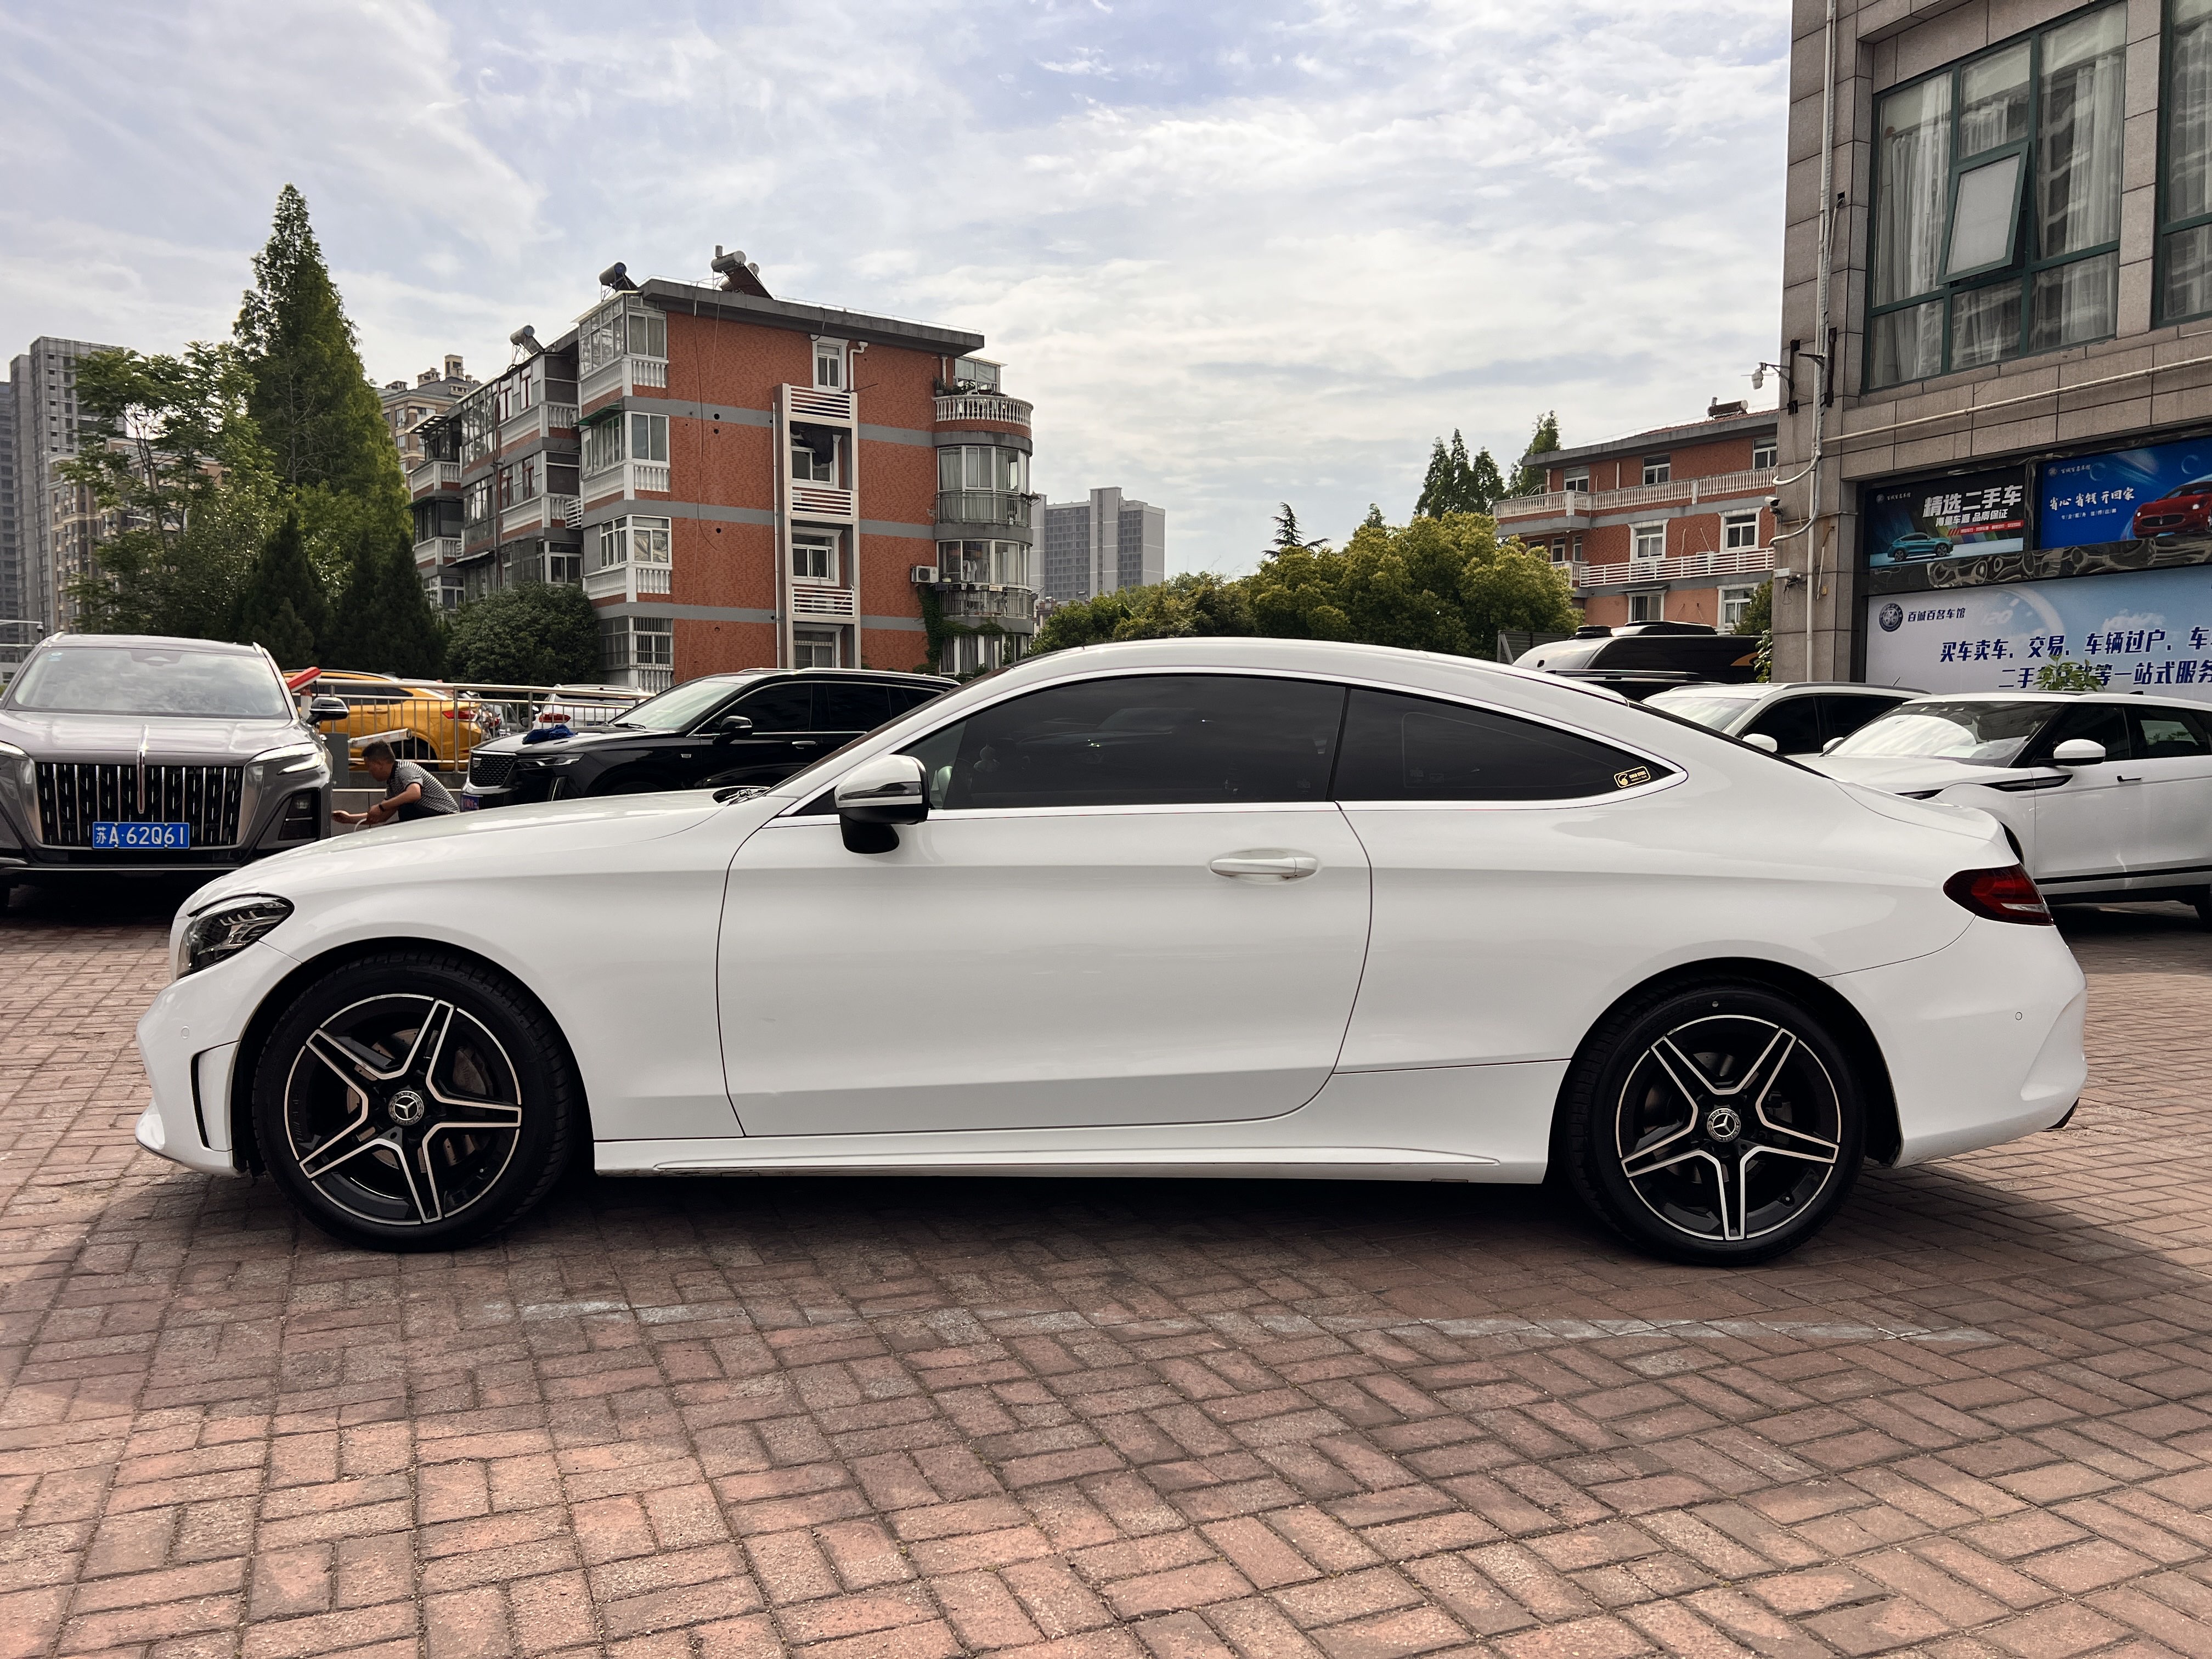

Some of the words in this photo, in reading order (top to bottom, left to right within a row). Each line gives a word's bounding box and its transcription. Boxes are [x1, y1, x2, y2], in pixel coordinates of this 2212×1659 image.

[1922, 484, 2023, 518] 精选二手车
[2050, 496, 2072, 511] 省心
[2075, 493, 2097, 507] 省钱
[2101, 487, 2135, 504] 开回家
[1936, 514, 1971, 527] 海量车源
[1972, 509, 2008, 522] 品质保证
[1908, 607, 1966, 622] 百诚百名车馆
[1998, 659, 2212, 689] 二手等一站式服务
